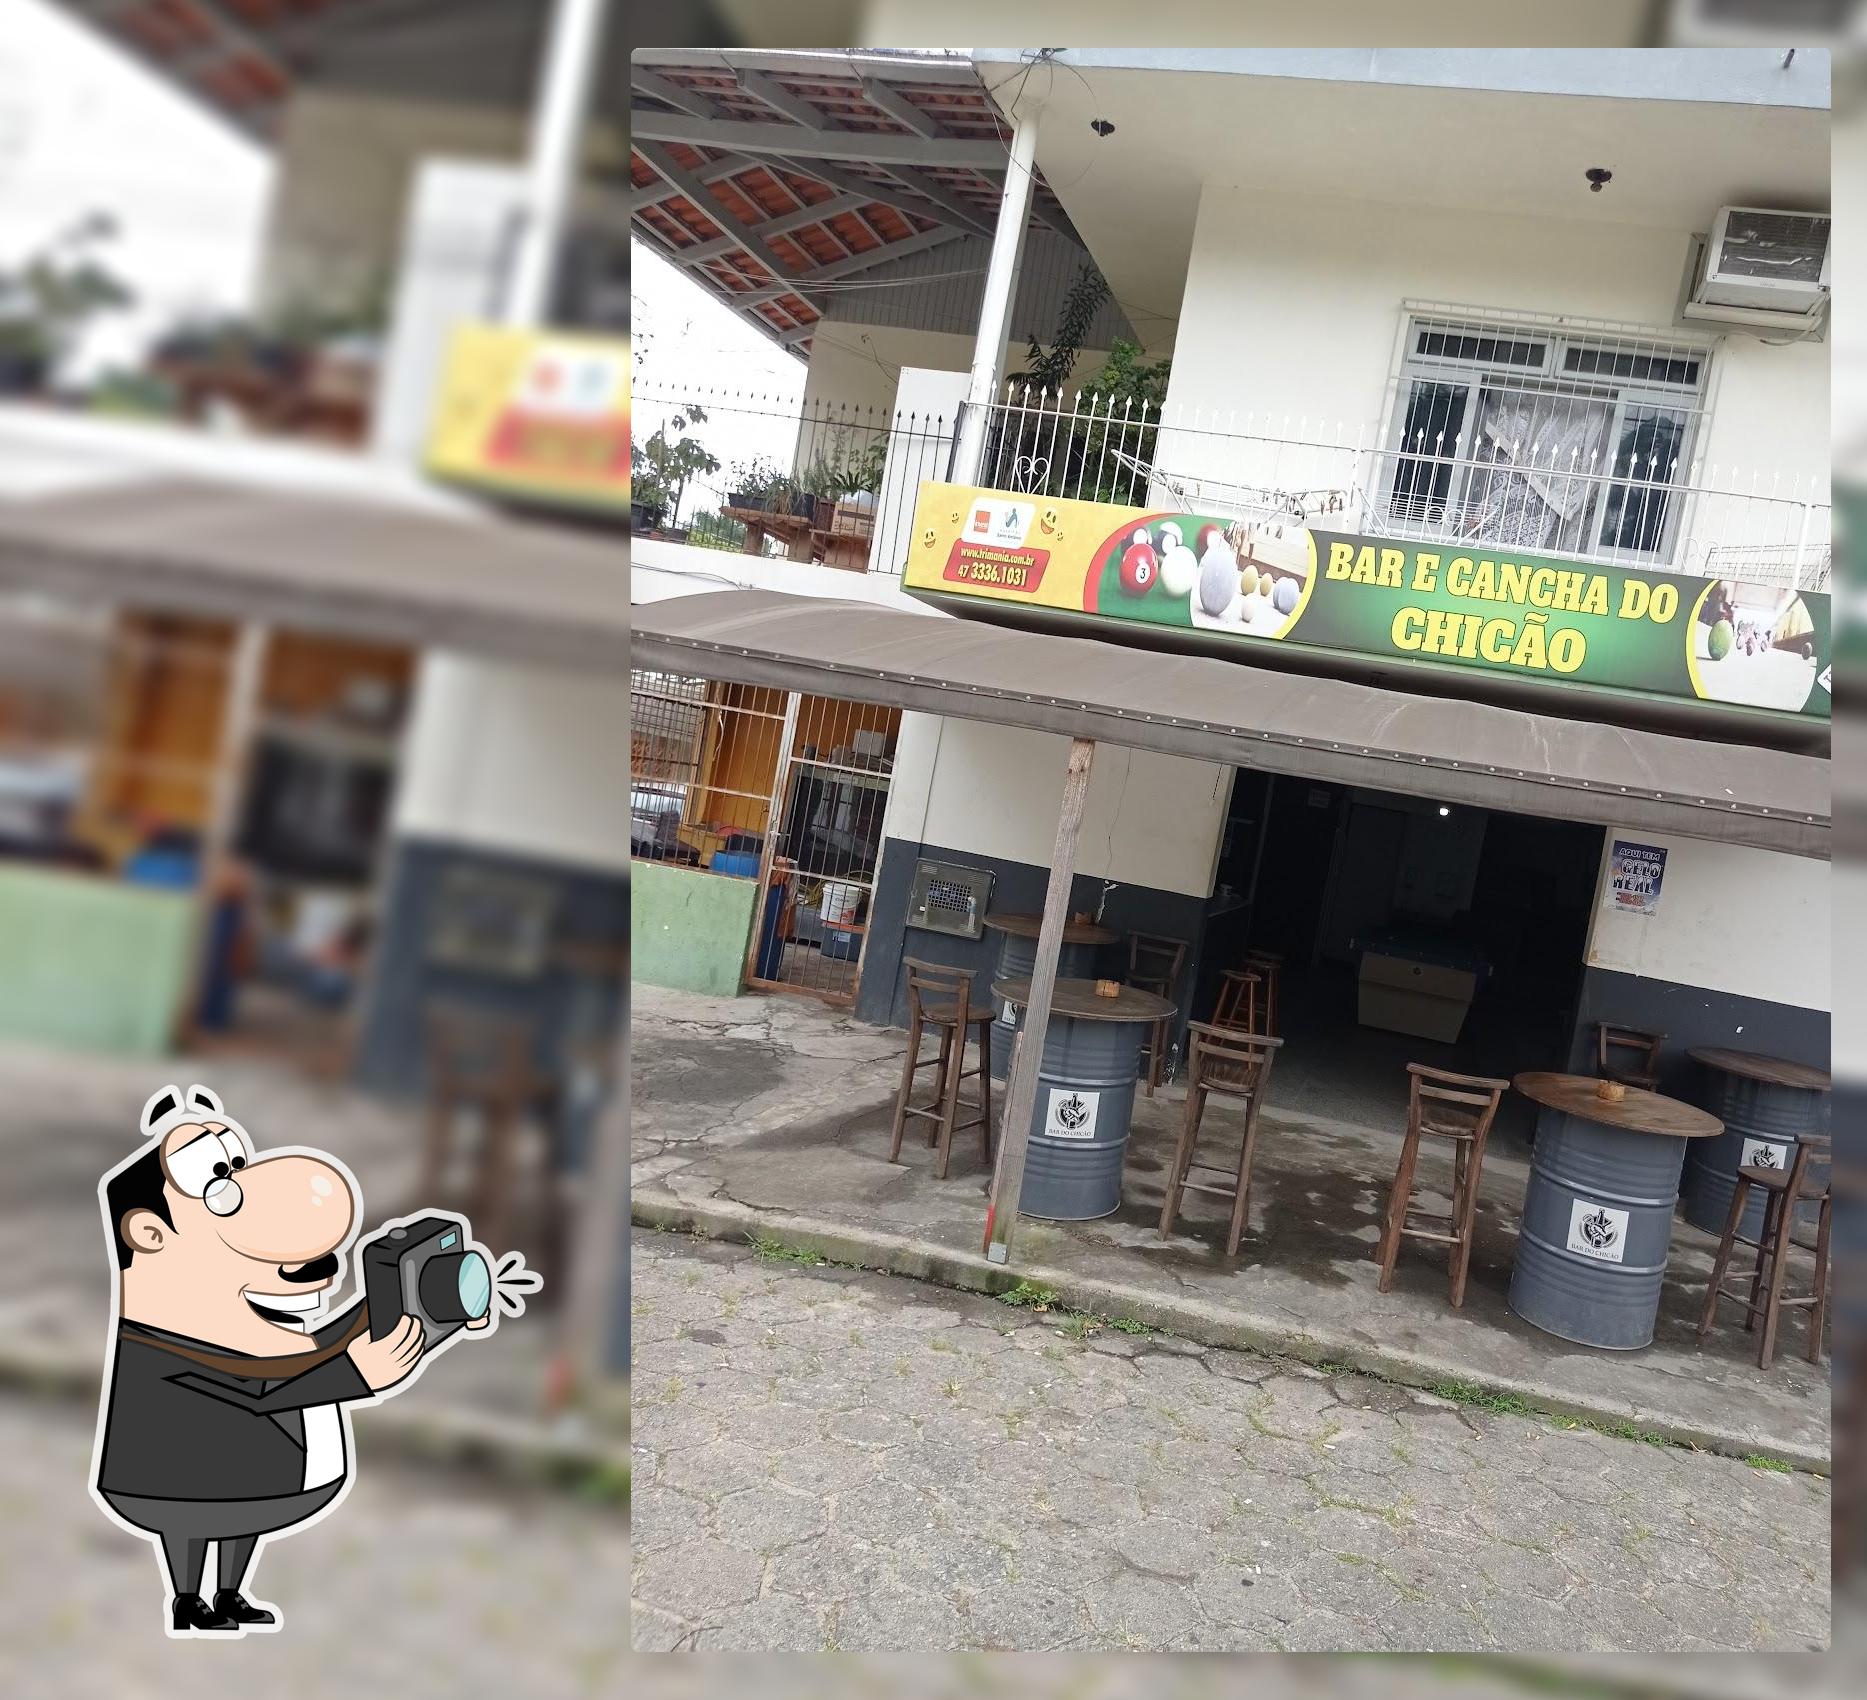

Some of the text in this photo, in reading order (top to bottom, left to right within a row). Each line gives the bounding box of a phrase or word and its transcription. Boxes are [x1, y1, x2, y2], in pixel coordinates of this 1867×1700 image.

[961, 547, 1034, 567] www.trimania.com.br
[958, 562, 1027, 586] 47 3336.1031
[1140, 567, 1146, 579] 3
[1326, 542, 1679, 624] BAR E CANCHA DO
[1391, 606, 1587, 673] CHICÃO
[1619, 847, 1640, 858] AQUI
[1642, 850, 1660, 861] TEM
[1621, 858, 1661, 879] GELO
[1612, 874, 1655, 896] REAL
